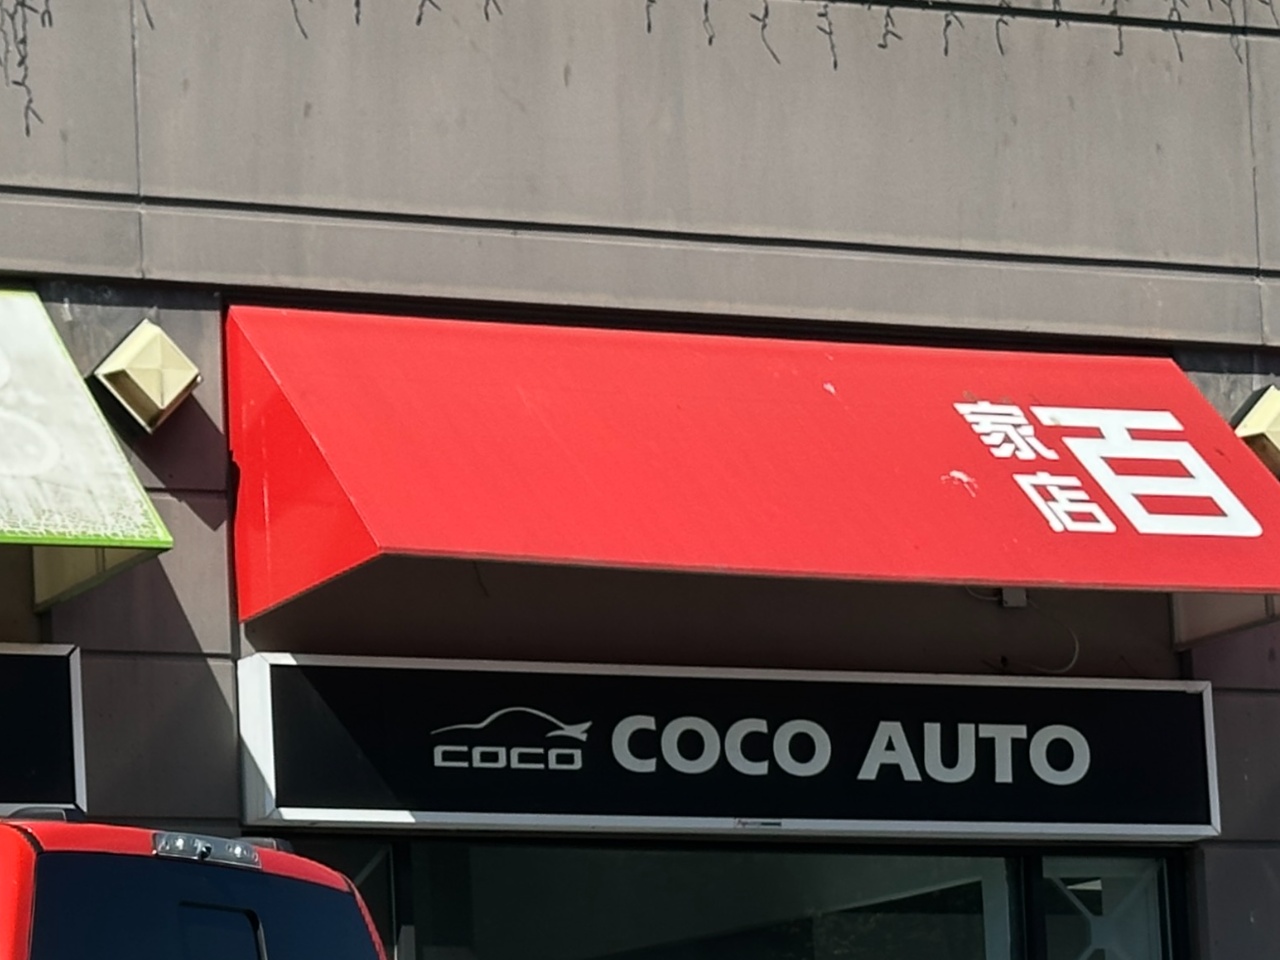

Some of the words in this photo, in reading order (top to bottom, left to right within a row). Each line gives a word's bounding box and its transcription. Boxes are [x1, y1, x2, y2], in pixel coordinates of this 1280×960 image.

[433, 745, 584, 770] COCO
[611, 715, 832, 777] COCO
[857, 721, 1091, 785] AUTO
